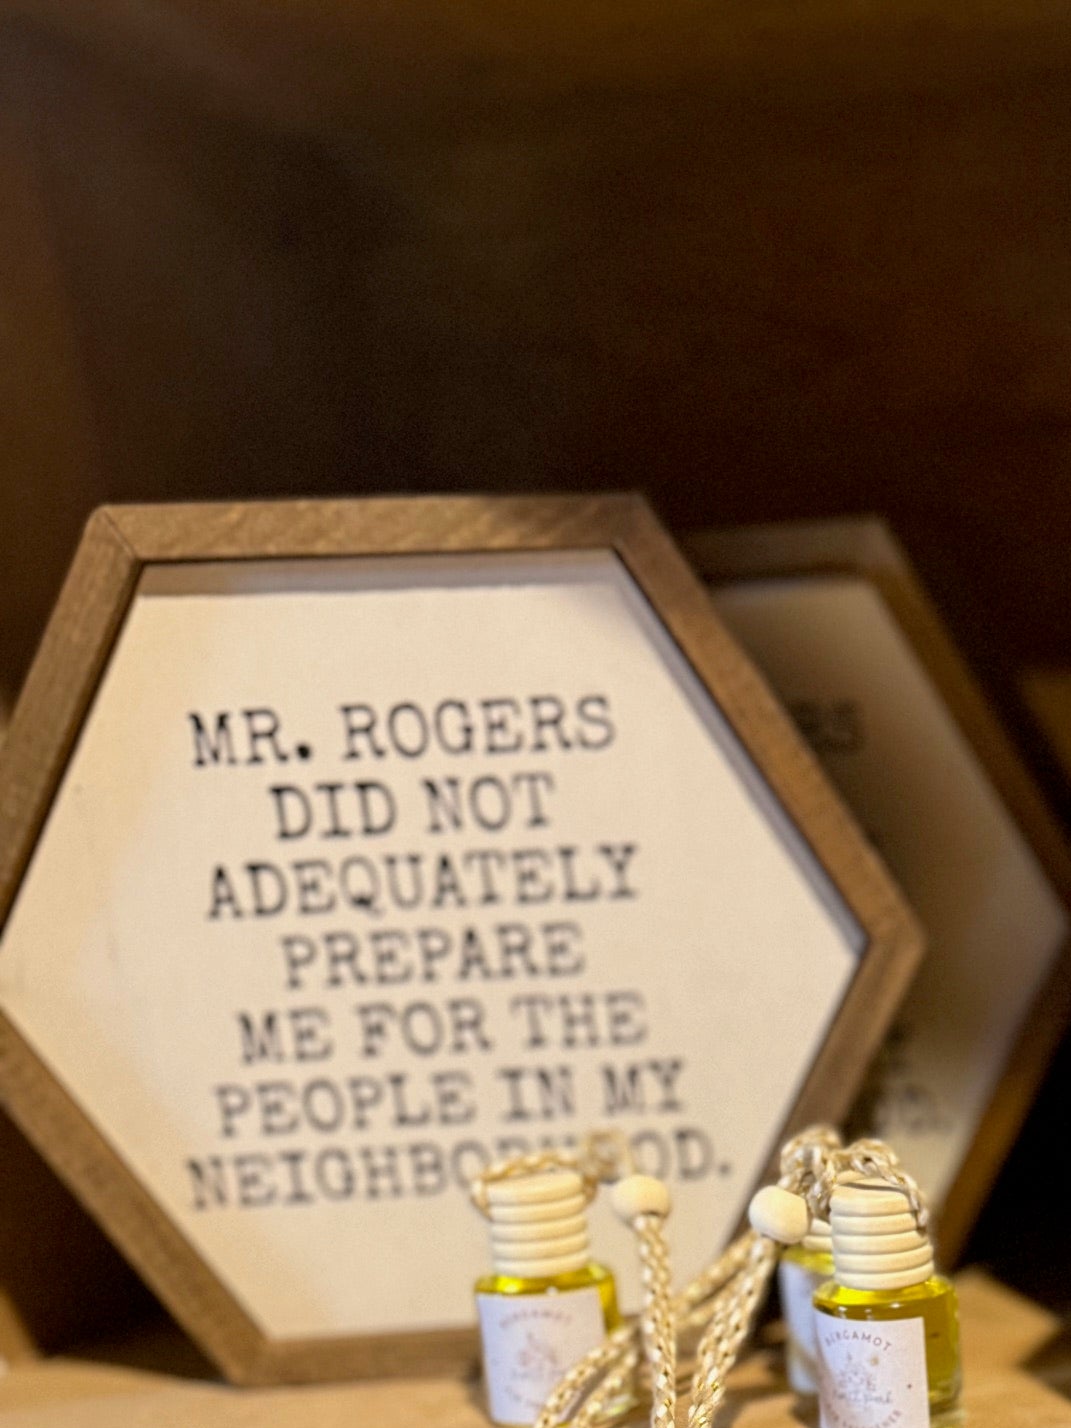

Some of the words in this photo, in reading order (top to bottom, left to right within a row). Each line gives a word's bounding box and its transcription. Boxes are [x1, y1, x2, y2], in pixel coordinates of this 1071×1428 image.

[187, 707, 313, 768] MR.
[338, 694, 615, 762] ROGERS
[267, 779, 397, 842] DID
[420, 771, 554, 835] NOT
[207, 842, 637, 921] ADEQUATELY
[280, 921, 584, 991] PREPARE
[237, 1007, 332, 1066] ME
[356, 997, 493, 1059] FOR
[510, 990, 648, 1050] THE
[214, 1069, 477, 1140] PEOPLE
[499, 1065, 574, 1123] IN
[601, 1058, 683, 1115] MY
